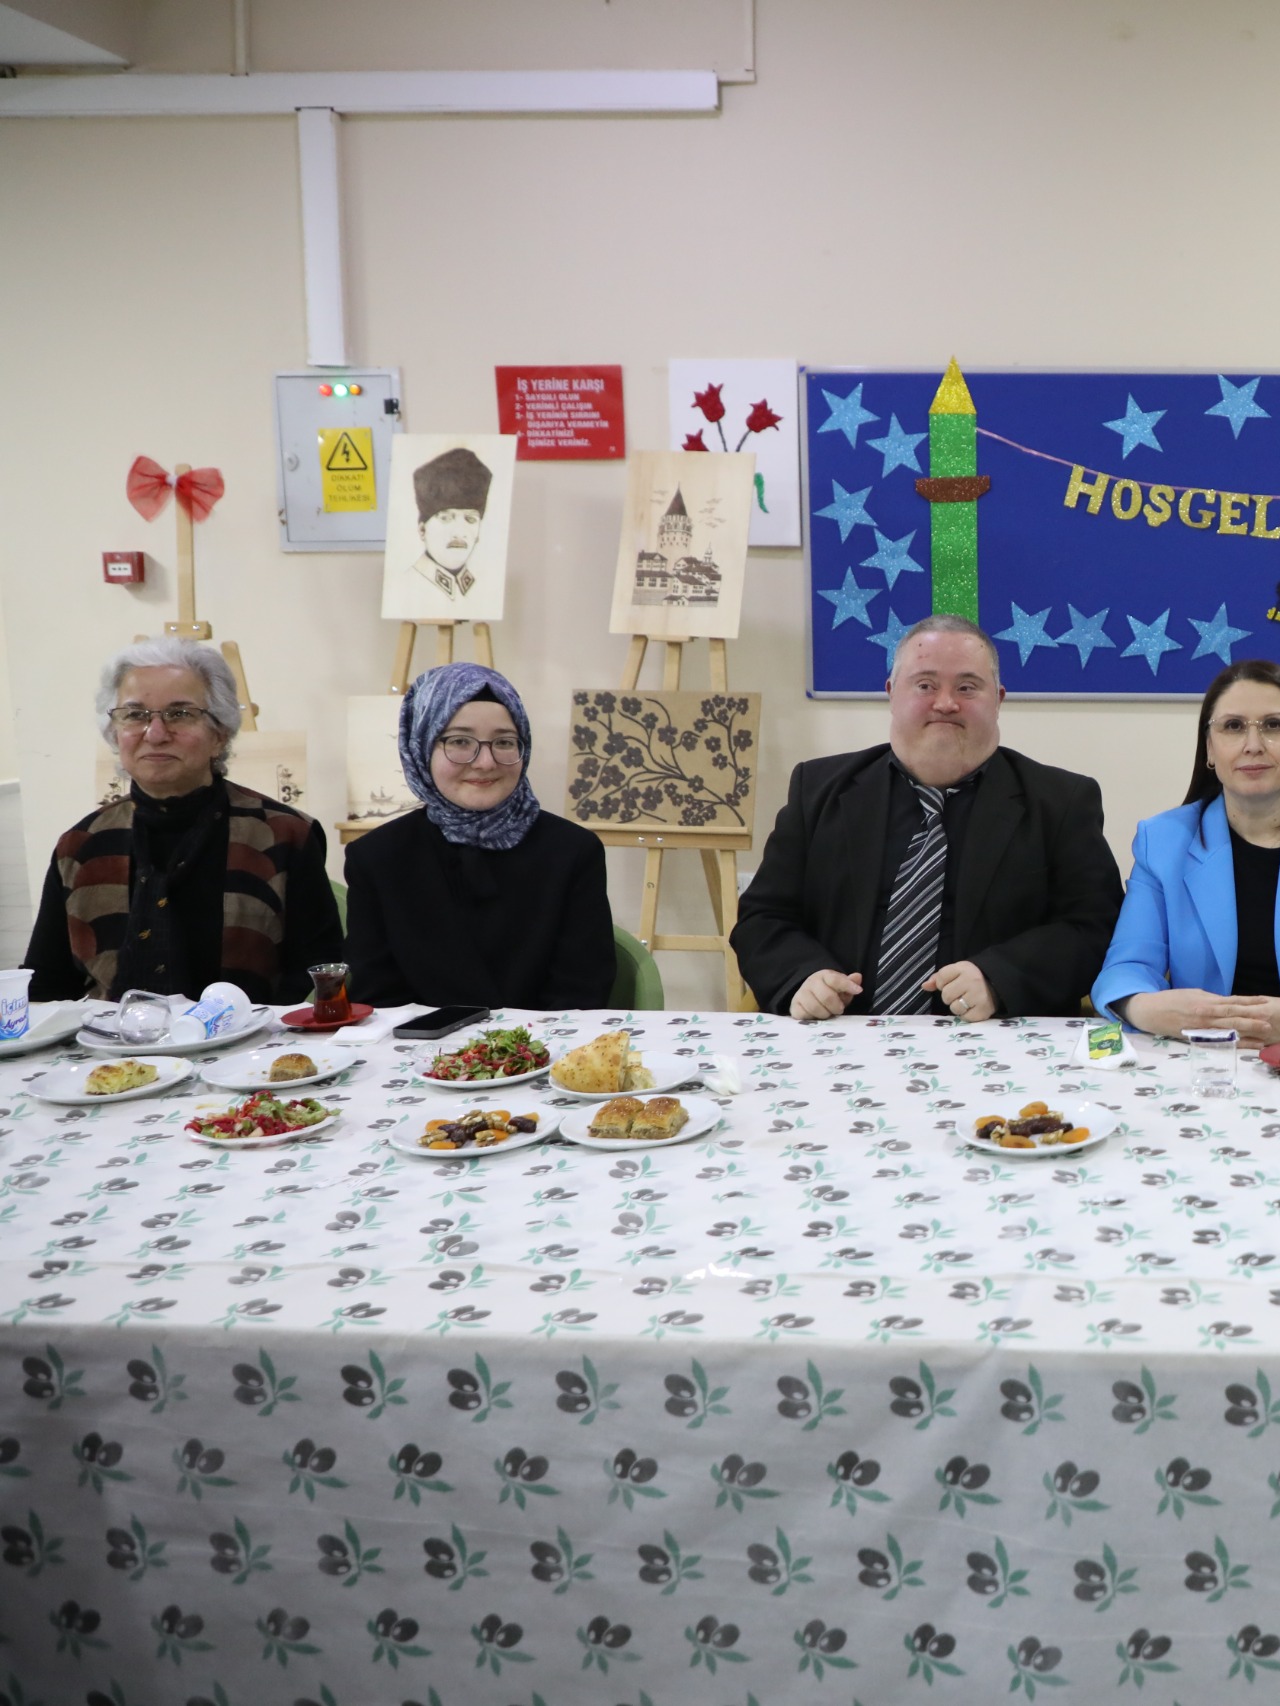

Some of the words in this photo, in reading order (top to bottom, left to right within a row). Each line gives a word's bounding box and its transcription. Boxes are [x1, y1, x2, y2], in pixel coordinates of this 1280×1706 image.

[517, 377, 528, 393] İŞ
[531, 377, 569, 391] YERİNE
[572, 378, 605, 394] KARŞI
[525, 393, 557, 401] SAYGILI
[558, 393, 580, 401] OLUN
[525, 402, 559, 410] VERİMLİ
[560, 402, 593, 411] ÇALIŞIN
